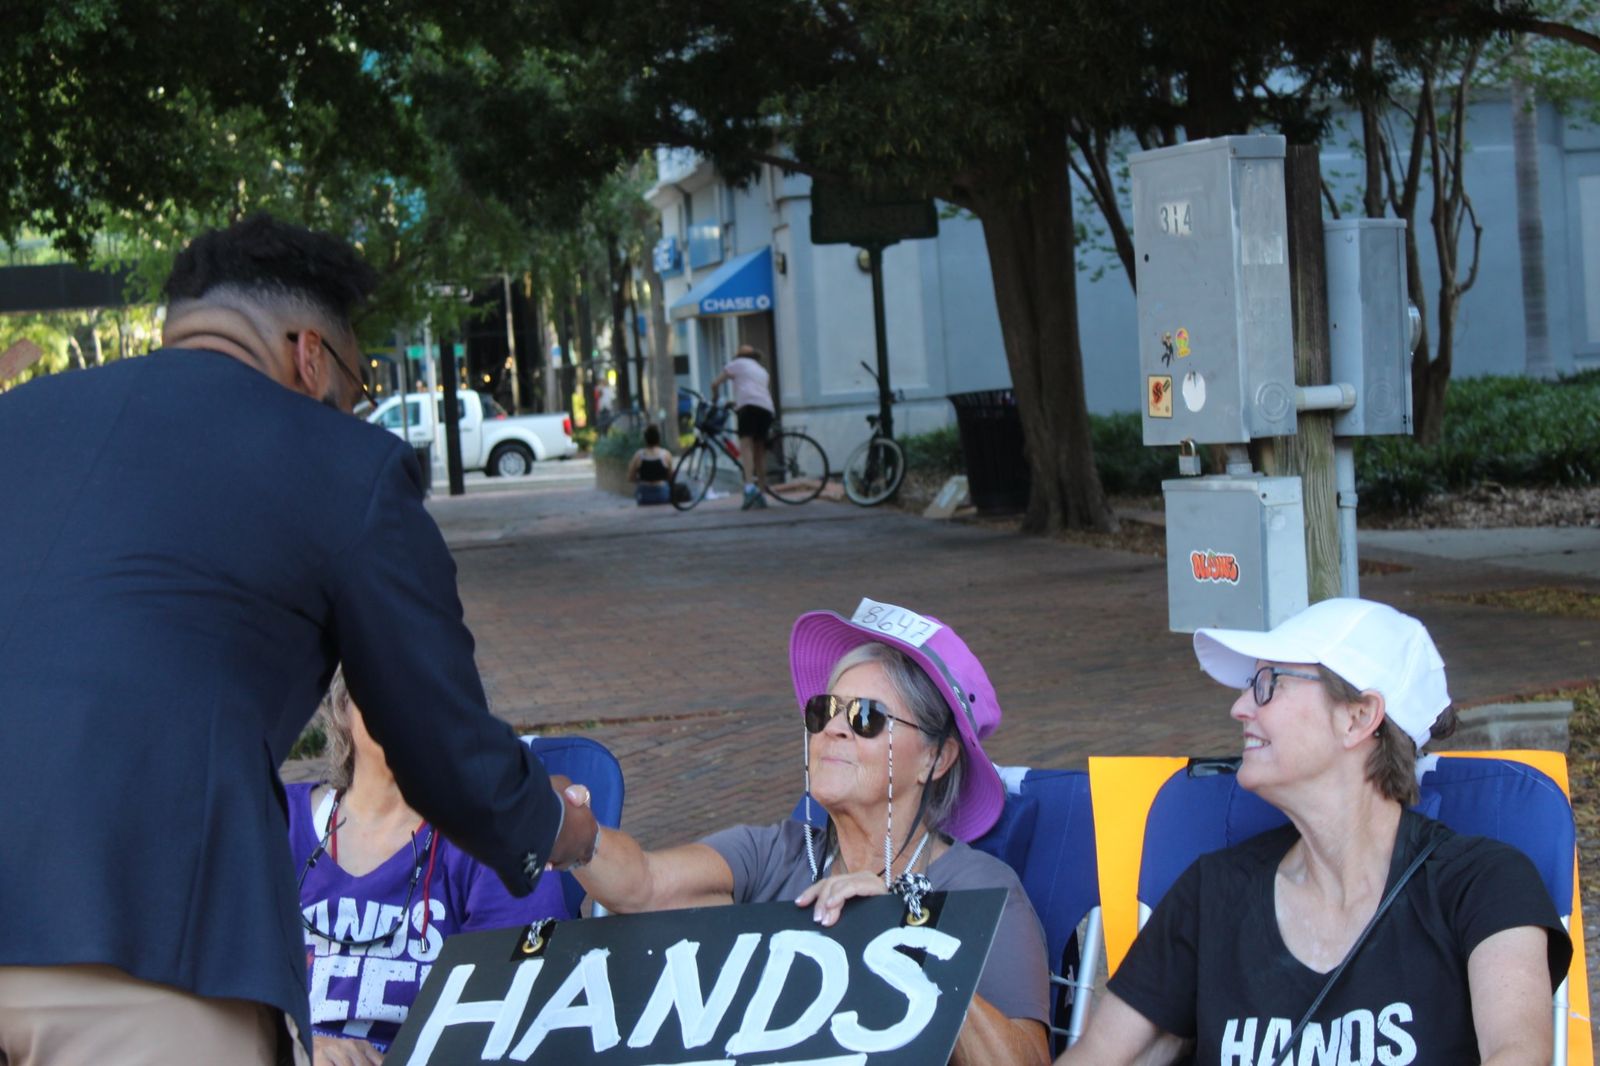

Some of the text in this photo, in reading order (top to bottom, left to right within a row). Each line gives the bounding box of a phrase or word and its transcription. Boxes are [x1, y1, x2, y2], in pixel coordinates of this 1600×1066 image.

[1160, 204, 1192, 234] 314
[703, 297, 754, 312] CHASE
[862, 606, 931, 639] 8647
[302, 897, 446, 963] ANDS
[407, 926, 962, 1066] HANDS
[1220, 1002, 1418, 1066] HANDS
